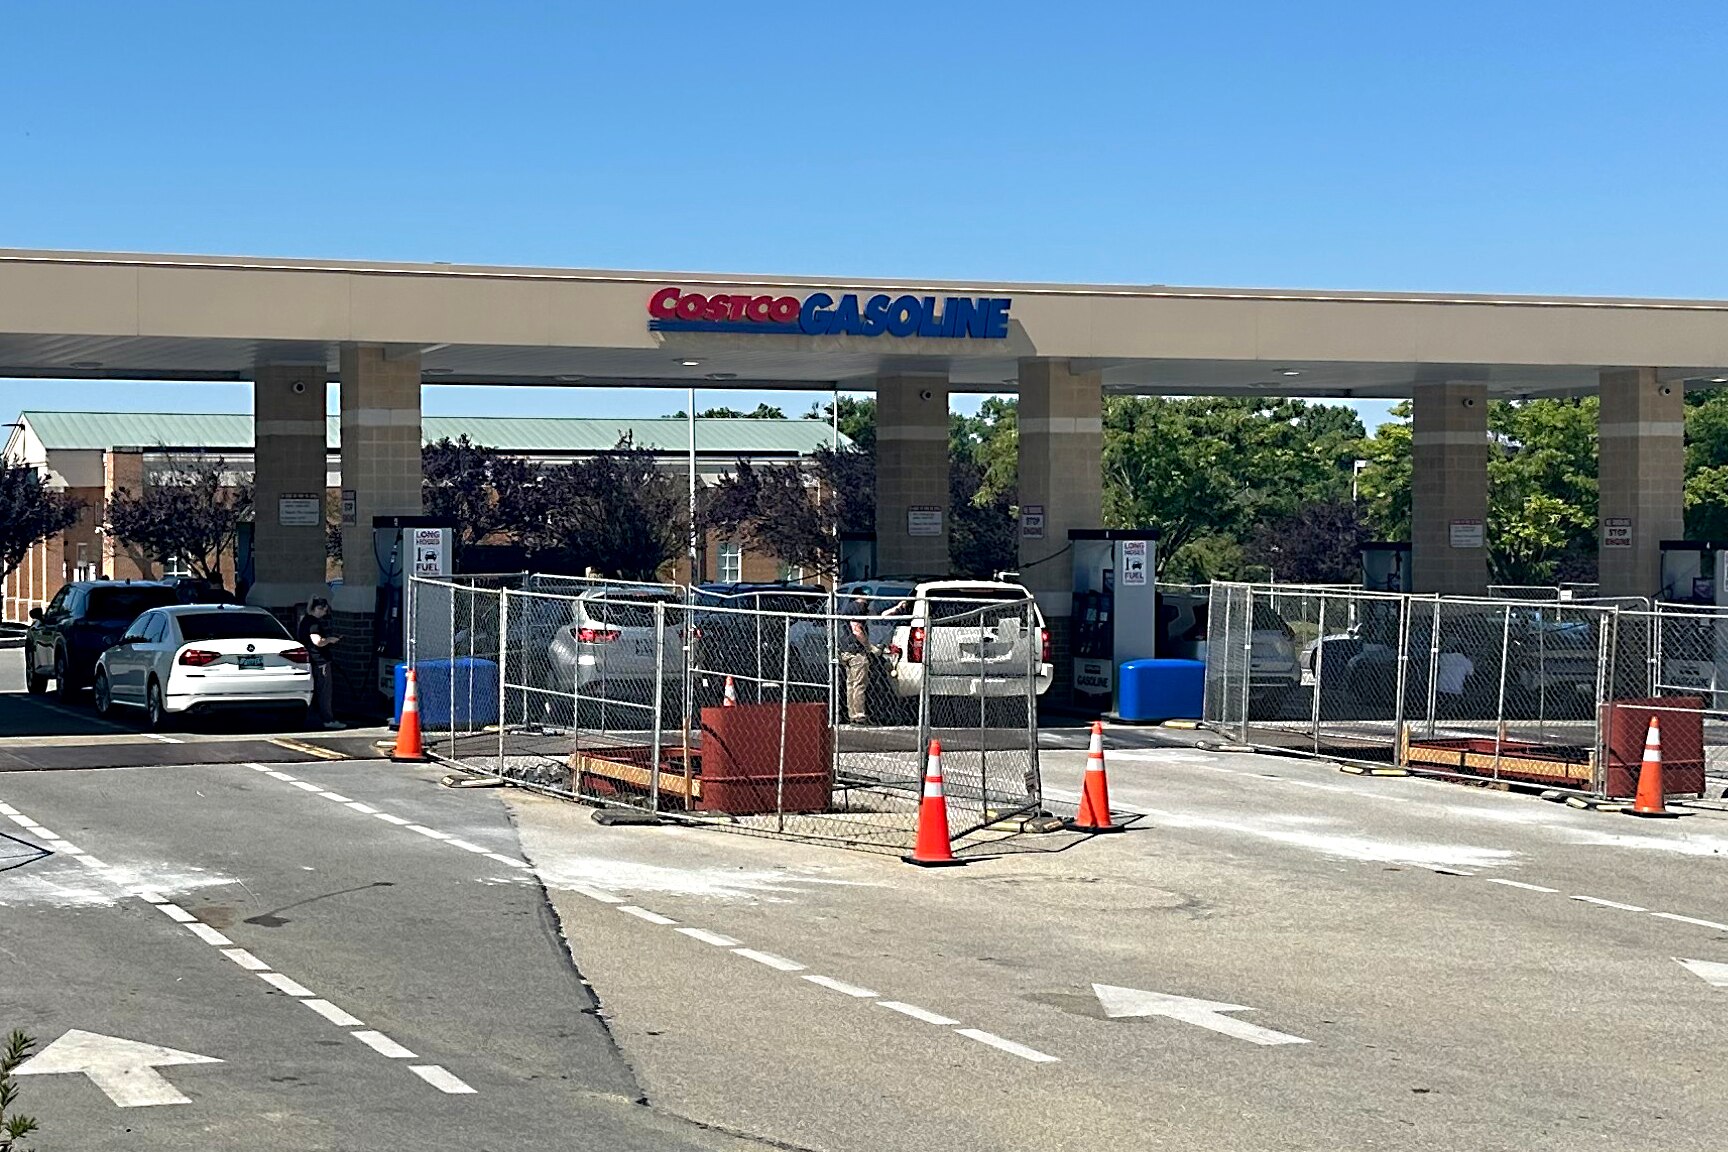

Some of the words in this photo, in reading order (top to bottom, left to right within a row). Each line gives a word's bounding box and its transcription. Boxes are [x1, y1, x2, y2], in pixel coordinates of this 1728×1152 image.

[648, 287, 801, 323] COSTCO
[799, 292, 1012, 339] GASOLINE
[416, 530, 440, 538] LONG
[1608, 528, 1628, 537] STOP
[416, 562, 440, 571] FUEL
[1124, 571, 1145, 580] FUEL
[1077, 675, 1109, 688] GASOLINE
